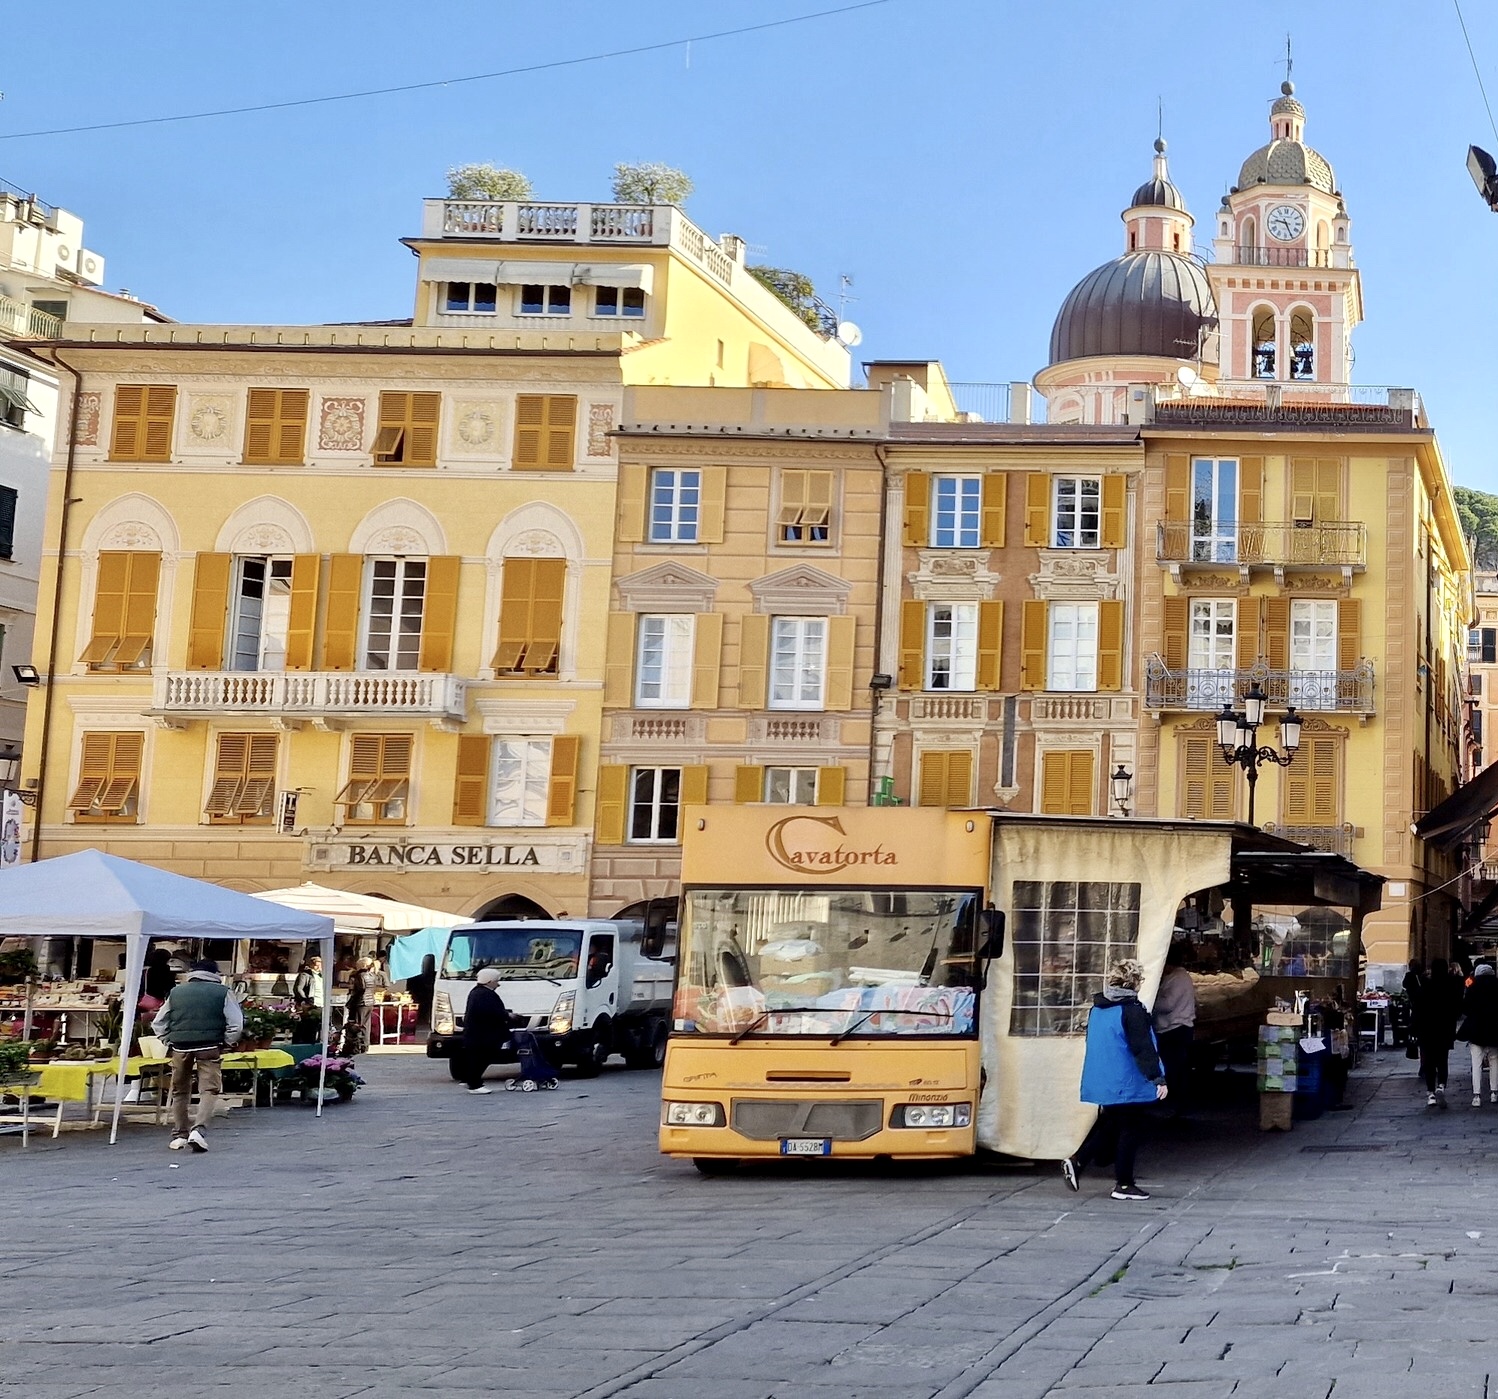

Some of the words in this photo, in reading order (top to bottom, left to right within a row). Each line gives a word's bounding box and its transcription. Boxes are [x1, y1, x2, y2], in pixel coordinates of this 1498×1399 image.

[347, 845, 443, 865] BANCA
[451, 845, 540, 866] SELLA
[765, 815, 898, 875] Cavatorta
